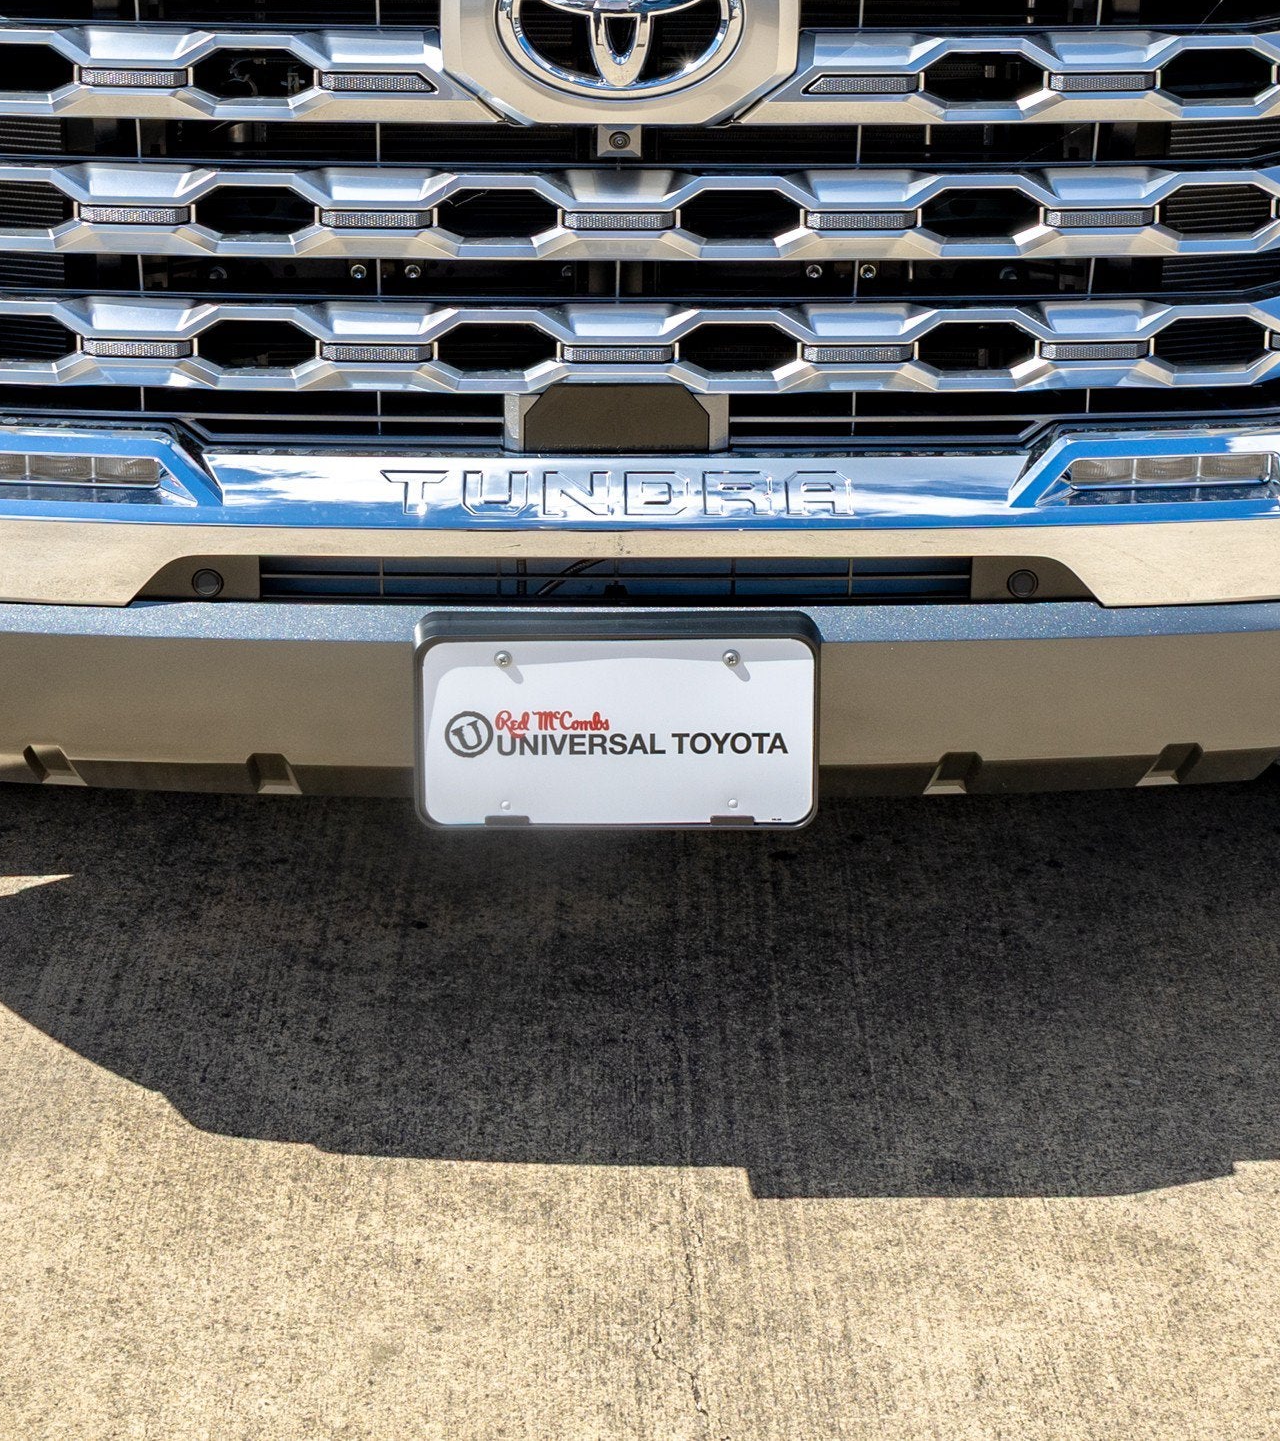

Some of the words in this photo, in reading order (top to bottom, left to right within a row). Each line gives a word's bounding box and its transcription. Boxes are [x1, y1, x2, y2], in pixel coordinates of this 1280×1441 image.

[380, 469, 855, 517] TUNDRA
[495, 709, 530, 738] Red
[532, 710, 610, 732] McCombs
[497, 732, 666, 756] UNIVERSAL
[671, 732, 789, 755] TOYOTA
